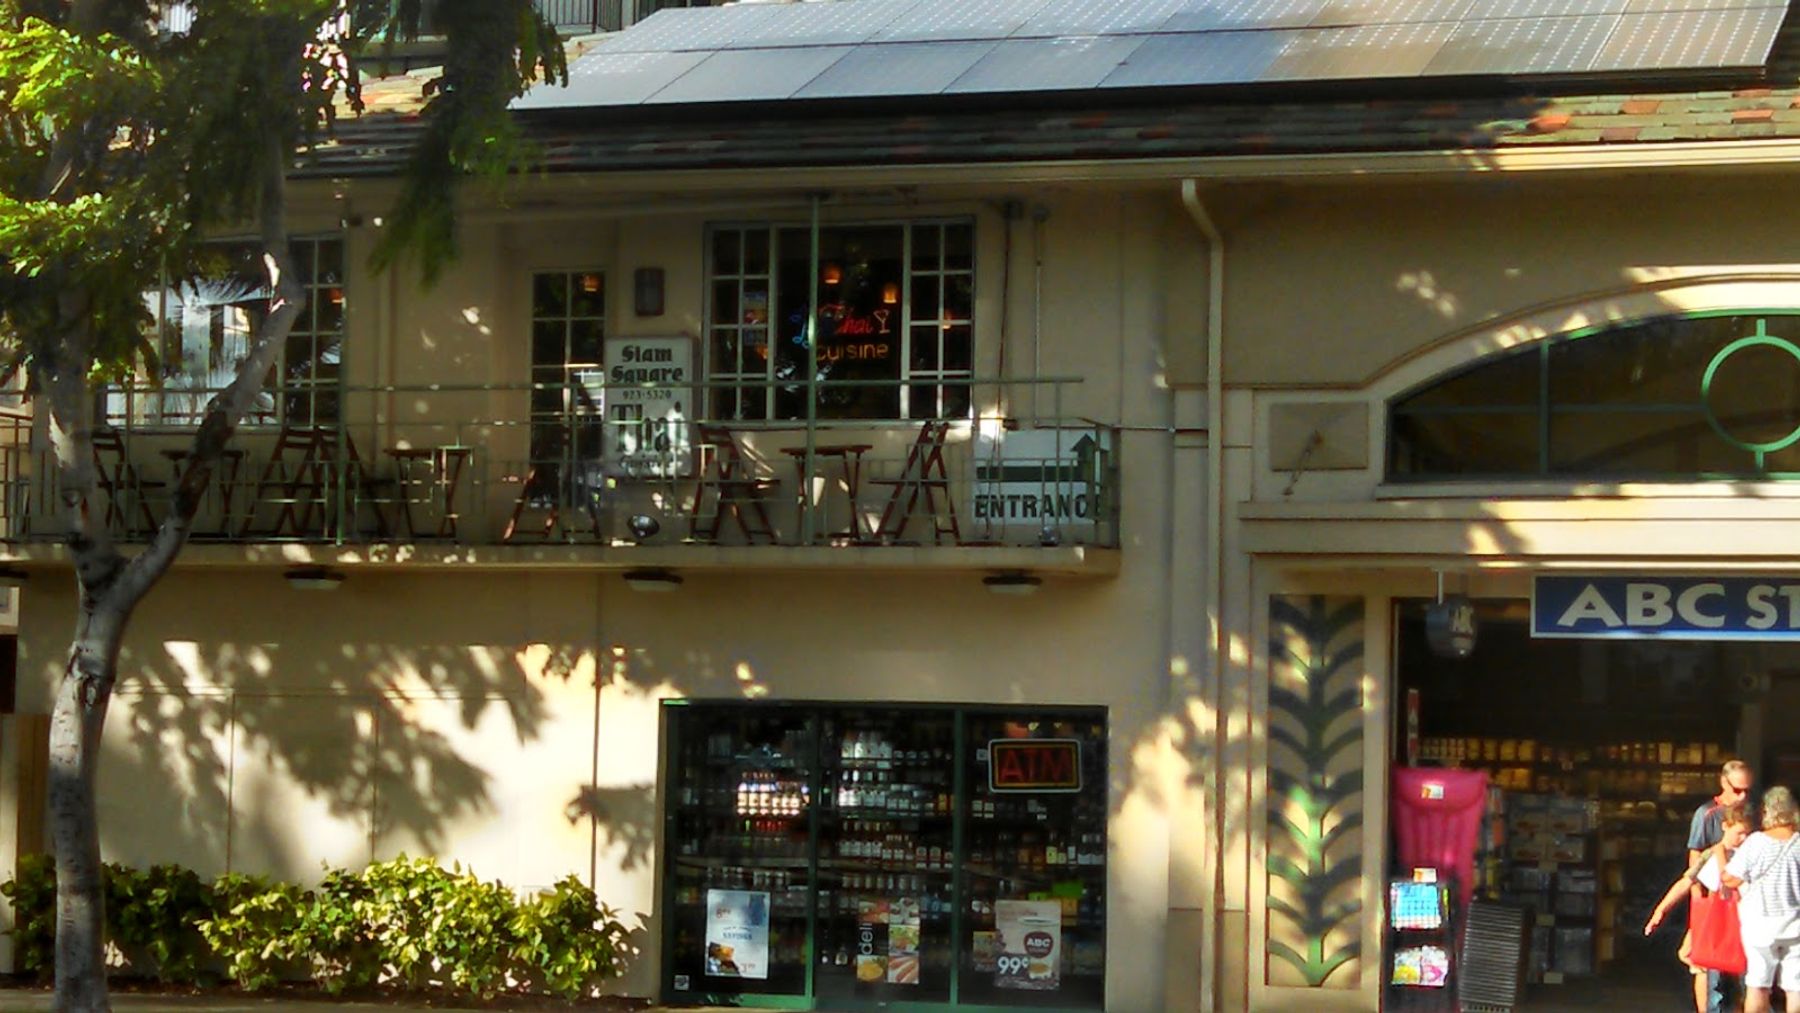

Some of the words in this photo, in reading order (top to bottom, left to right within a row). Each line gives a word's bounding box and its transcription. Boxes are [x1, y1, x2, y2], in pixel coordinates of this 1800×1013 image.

[622, 344, 672, 362] Siam
[611, 365, 683, 383] Square
[1556, 583, 1726, 628] ABC
[999, 748, 1074, 784] ATM
[859, 922, 873, 955] deli
[1026, 937, 1051, 948] ABC
